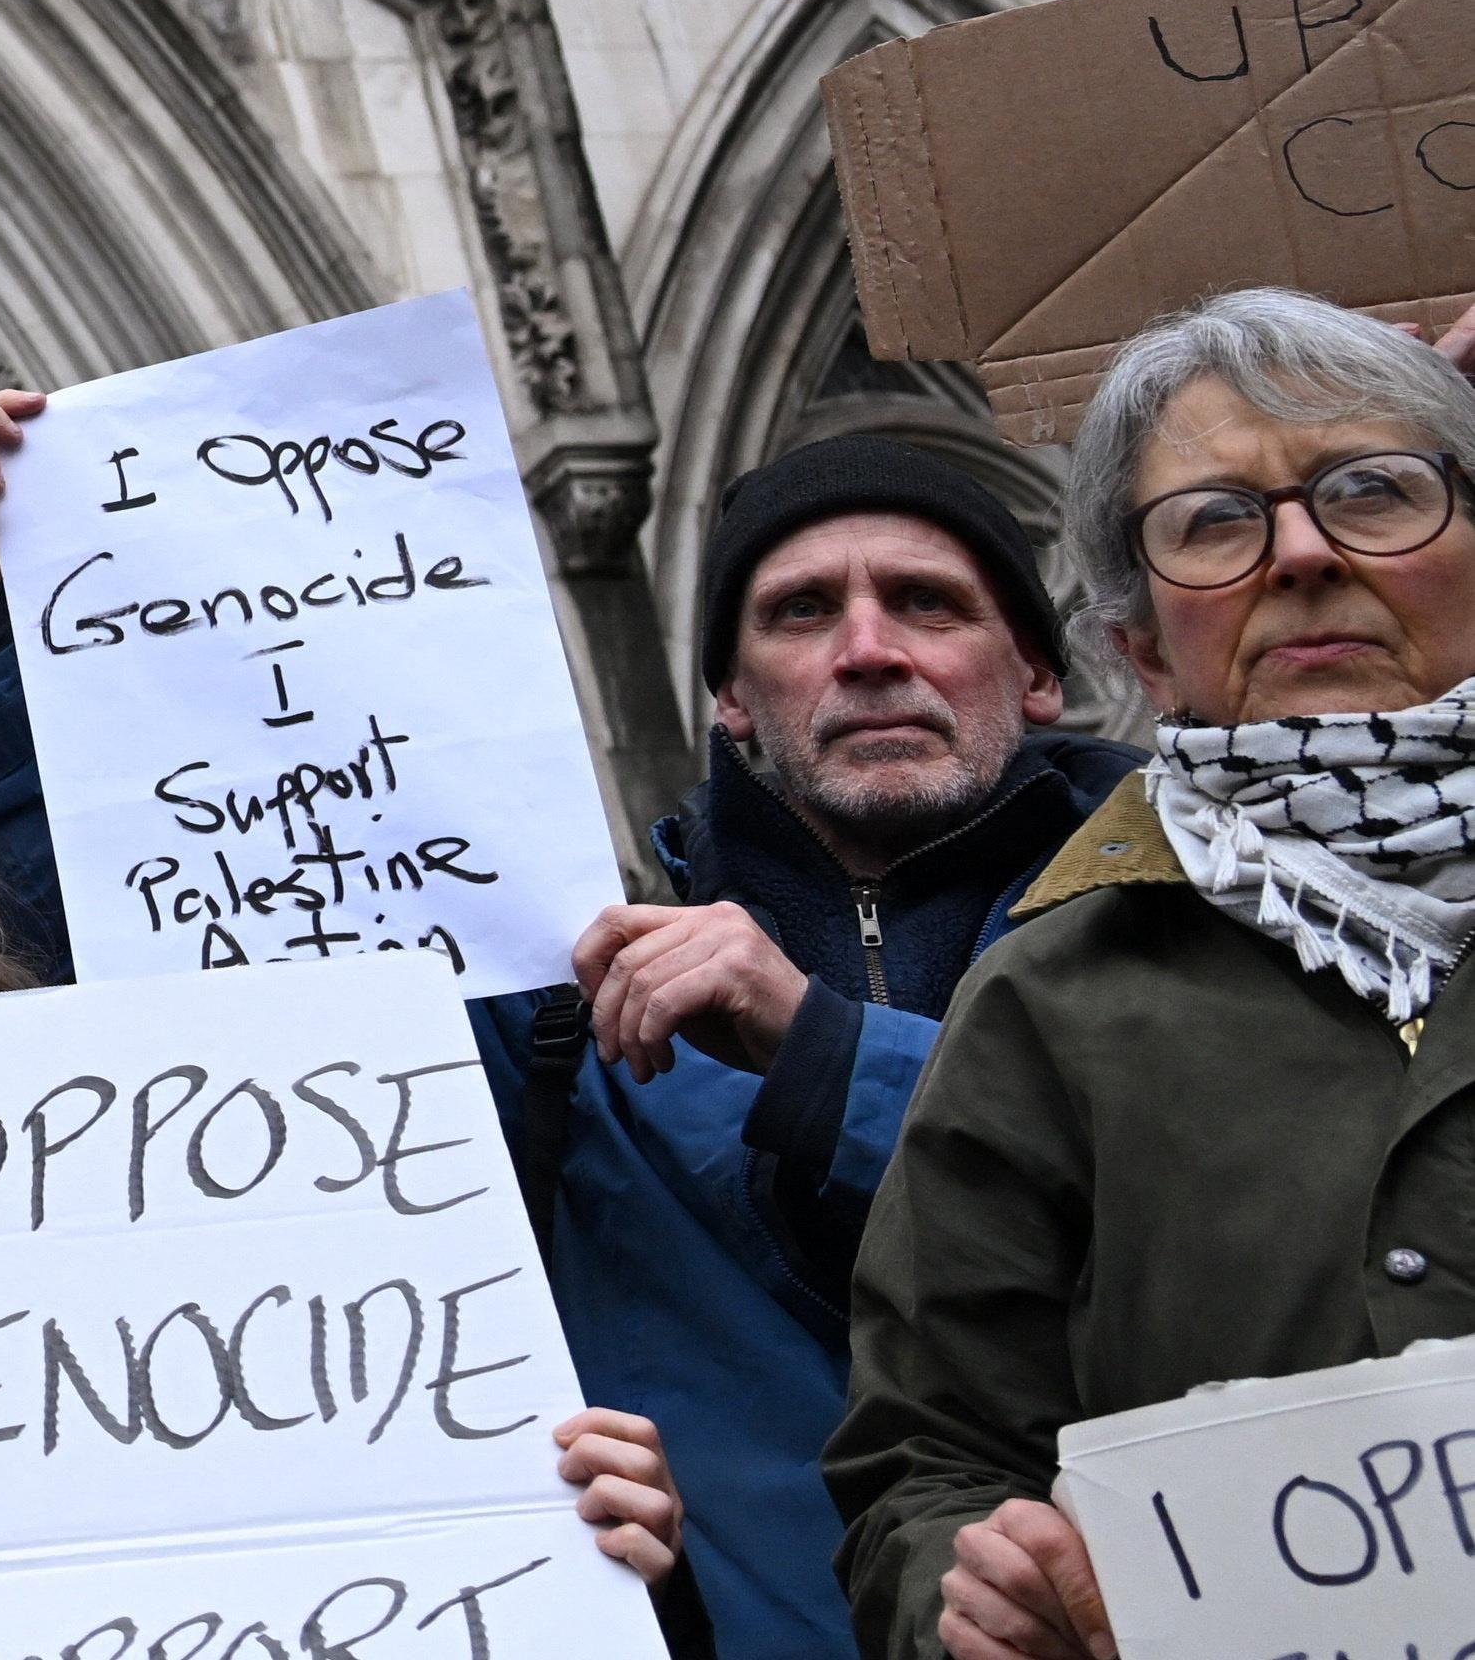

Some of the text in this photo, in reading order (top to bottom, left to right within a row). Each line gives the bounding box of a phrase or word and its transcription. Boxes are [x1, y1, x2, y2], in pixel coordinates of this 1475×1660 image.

[100, 447, 157, 513] I
[41, 531, 492, 655] Genocide
[242, 640, 314, 726] I
[154, 714, 410, 850] Support
[125, 815, 498, 933] Palestine
[1152, 1429, 1475, 1600] I OPP
